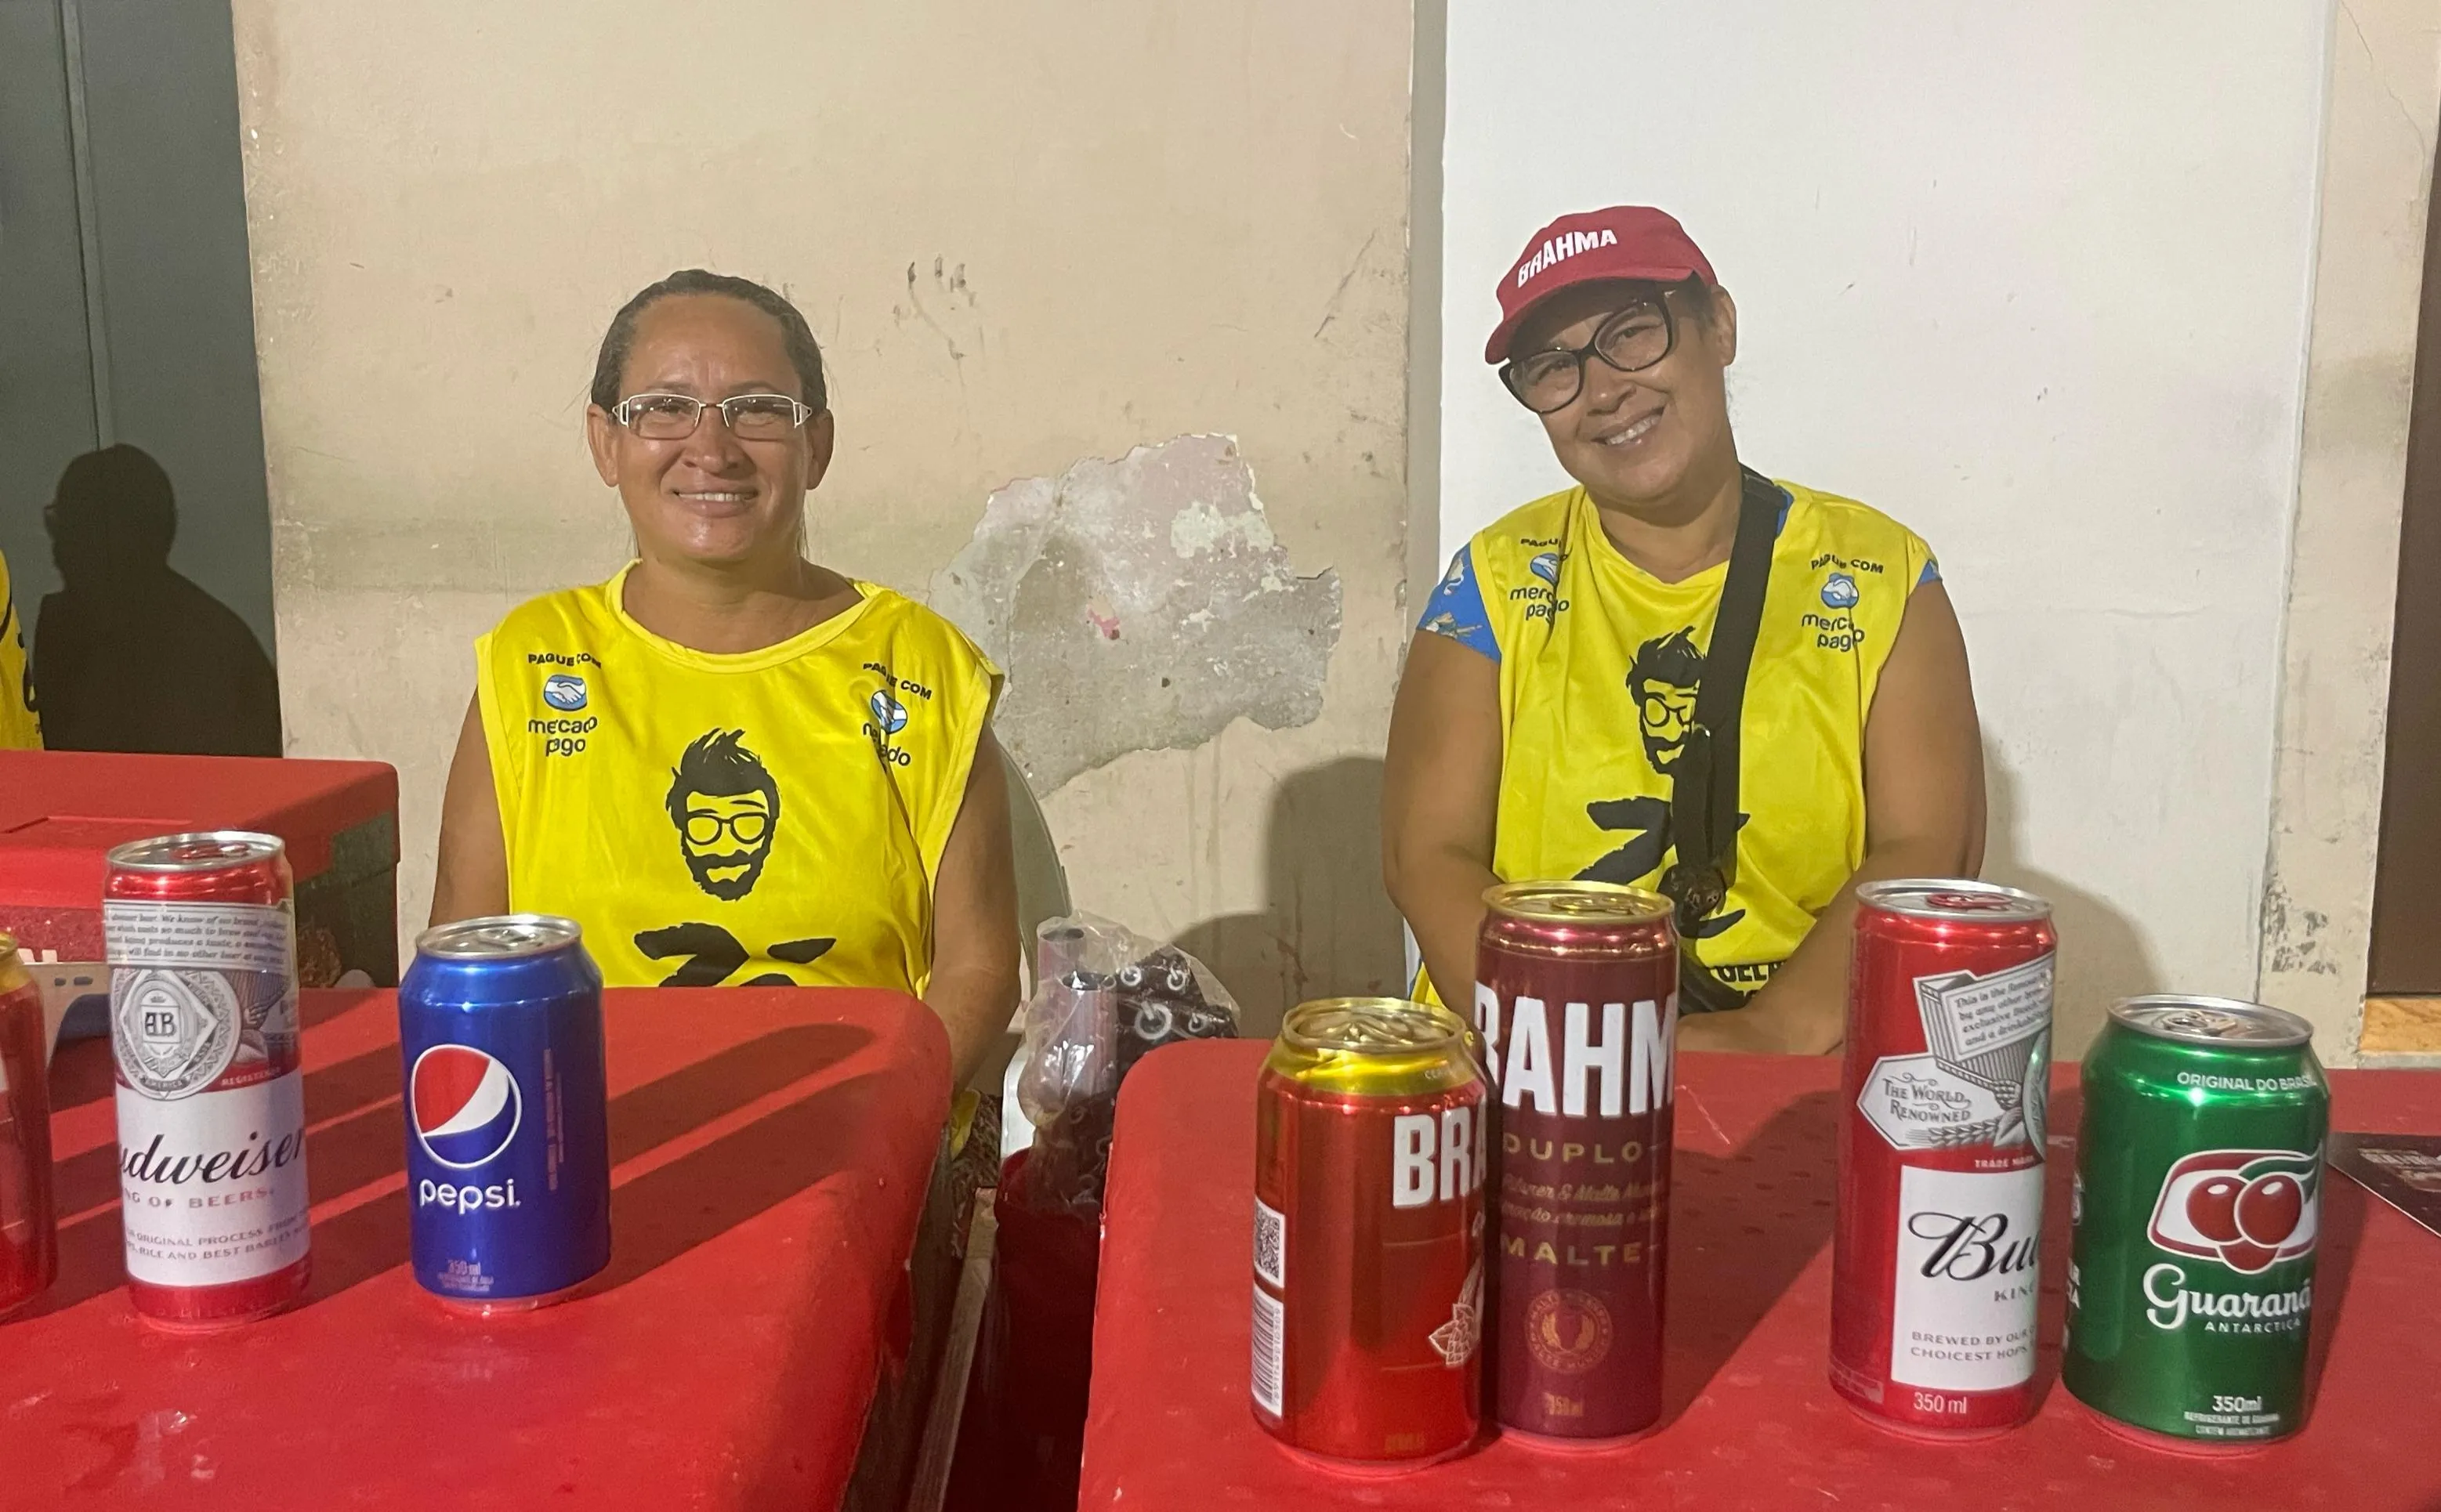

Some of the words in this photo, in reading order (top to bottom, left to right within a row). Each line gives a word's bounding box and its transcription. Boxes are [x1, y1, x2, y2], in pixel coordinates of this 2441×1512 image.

[1518, 229, 1617, 288] BRAHMA
[1851, 559, 1883, 573] COM
[528, 653, 574, 666] PAGUE
[900, 680, 932, 700] COM
[2177, 1072, 2254, 1091] ORIGINAL
[2256, 1078, 2278, 1091] DO
[1882, 1078, 1909, 1099] THE
[1910, 1083, 1972, 1110] WORLD
[1890, 1099, 1971, 1122] RENOWNED
[1503, 1133, 1642, 1163] DUPLO
[1975, 1159, 2008, 1168] TRADE
[149, 1195, 174, 1208] OF
[136, 1232, 193, 1246] ORIGINAL
[198, 1228, 264, 1246] PROCESS
[168, 1252, 197, 1261] AND
[203, 1246, 241, 1260] BEST
[1500, 1232, 1642, 1266] MALTE
[2142, 1263, 2311, 1329] Guaraná
[2204, 1318, 2301, 1333] ANTARCTICA
[1912, 1331, 1980, 1346] BREWED
[1986, 1336, 2002, 1345] BY
[1910, 1347, 1993, 1361] CHOICEST
[1914, 1391, 1944, 1413] 350
[1948, 1396, 1968, 1414] ml
[2212, 1395, 2262, 1413] 350ml
